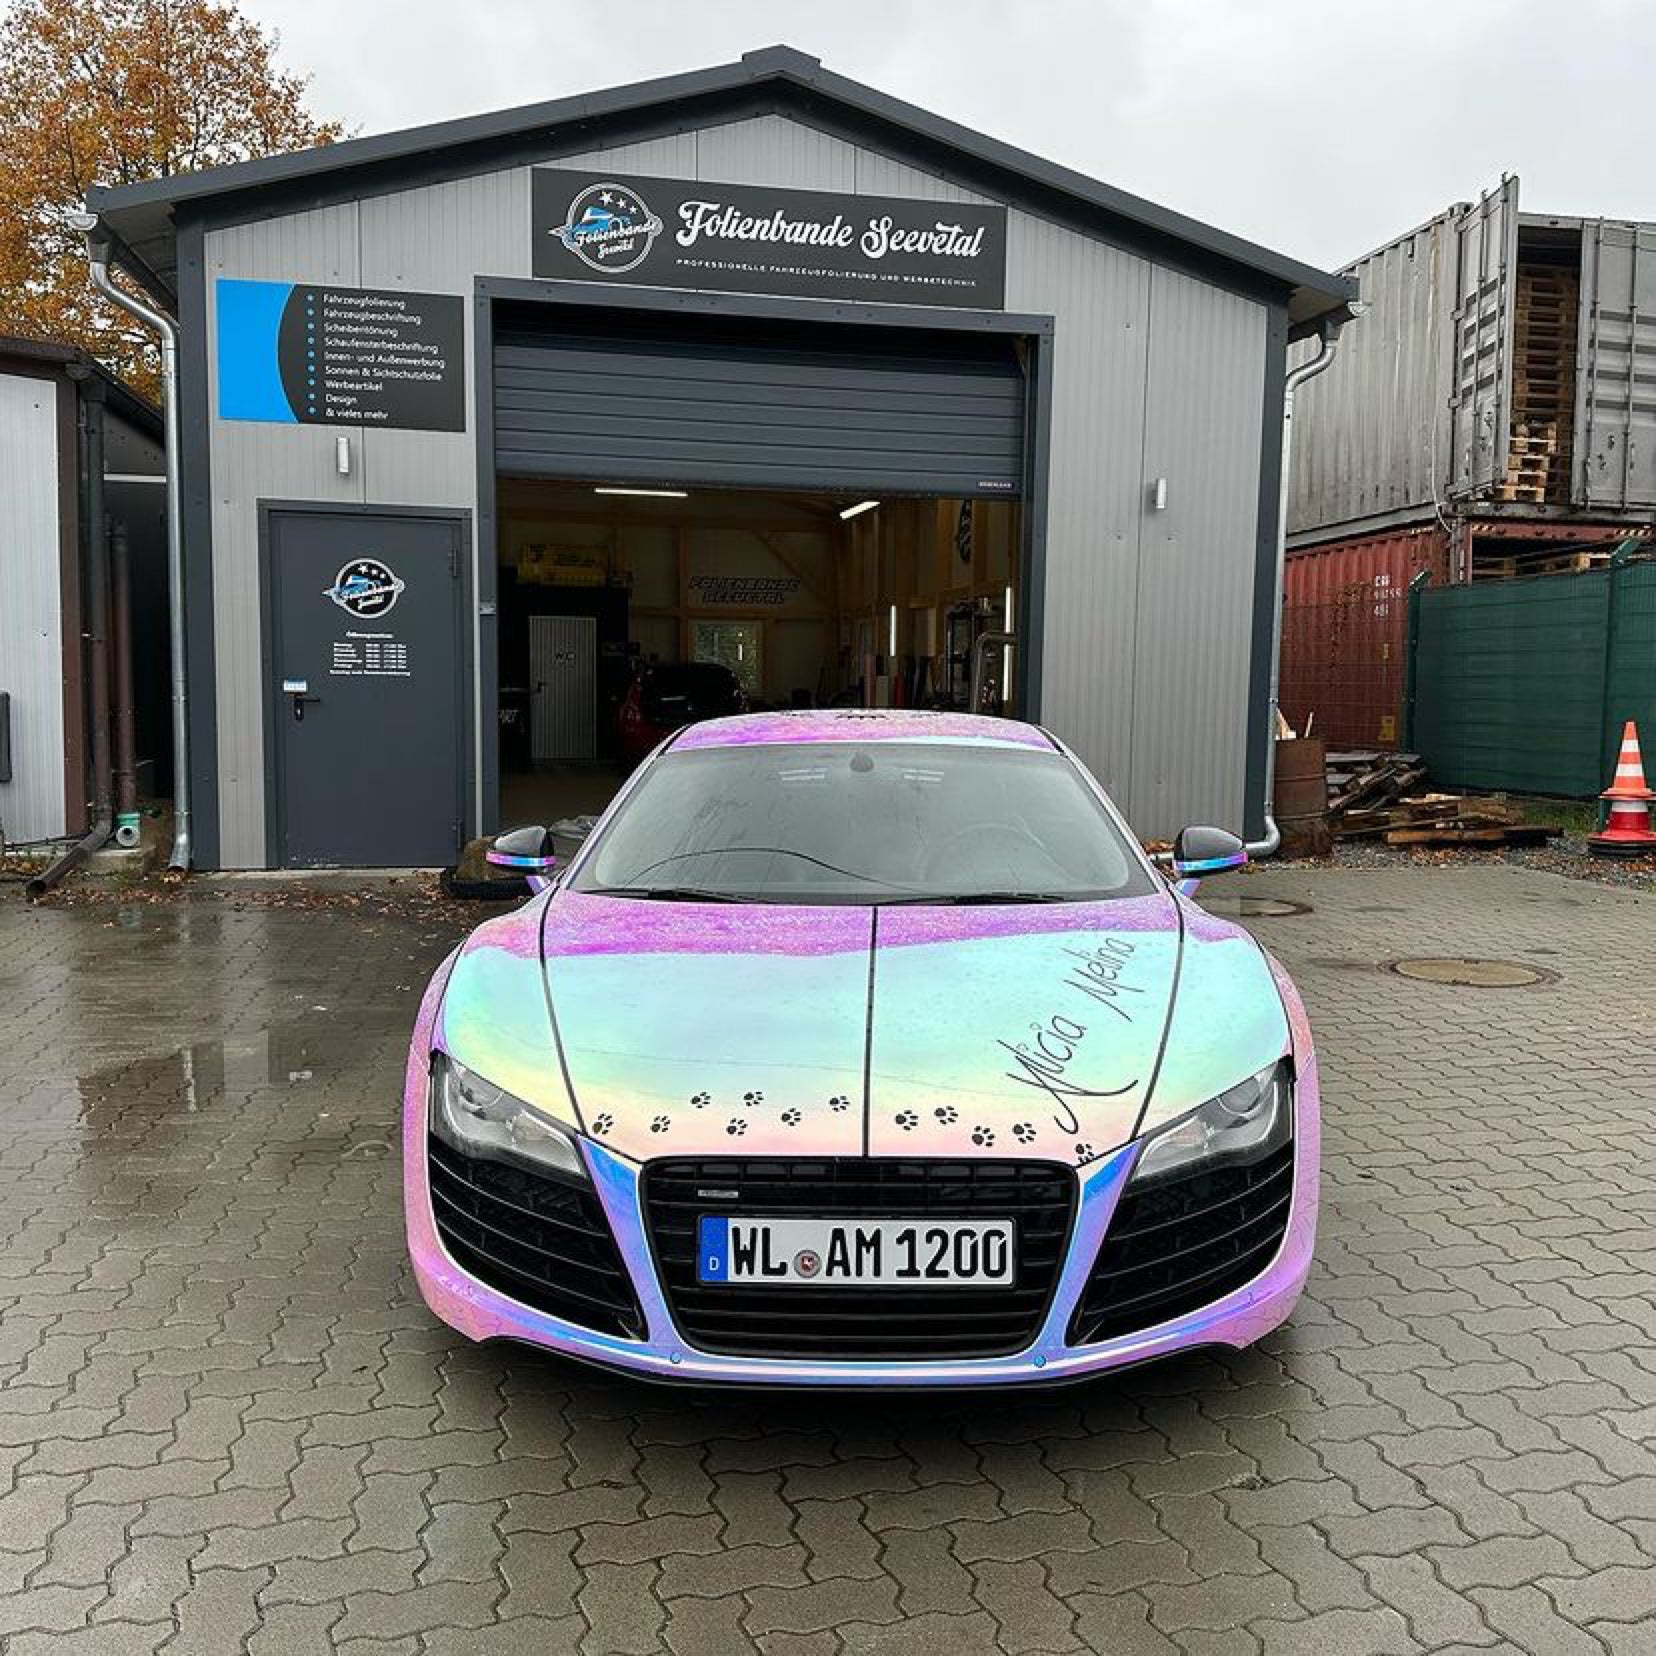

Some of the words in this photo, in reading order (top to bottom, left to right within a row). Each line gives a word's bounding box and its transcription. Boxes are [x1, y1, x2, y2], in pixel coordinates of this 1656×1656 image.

[675, 201, 854, 247] Folienbande
[860, 216, 984, 258] Seevetal
[676, 258, 766, 273] PROFESSIONELLE
[880, 272, 899, 282] UND
[323, 293, 406, 311] Fahrzeugfolierung
[323, 307, 422, 326] Fahrzeugbeschriftung
[323, 322, 399, 339] Scheibentönung
[323, 337, 439, 355] Schaufensterbeschriftung
[324, 351, 355, 361] Innen-
[357, 354, 375, 363] und
[376, 354, 445, 369] Außenwerbung
[324, 365, 360, 375] Sonnen
[361, 367, 371, 377] &
[324, 379, 383, 392] Werbeartikel
[325, 393, 358, 406] Design
[325, 407, 335, 417] &
[336, 408, 362, 419] vieles
[363, 410, 389, 420] mehr
[709, 1256, 719, 1271] D
[731, 1226, 788, 1276] WL
[825, 1227, 883, 1278] AM
[895, 1228, 1007, 1279] 1200
